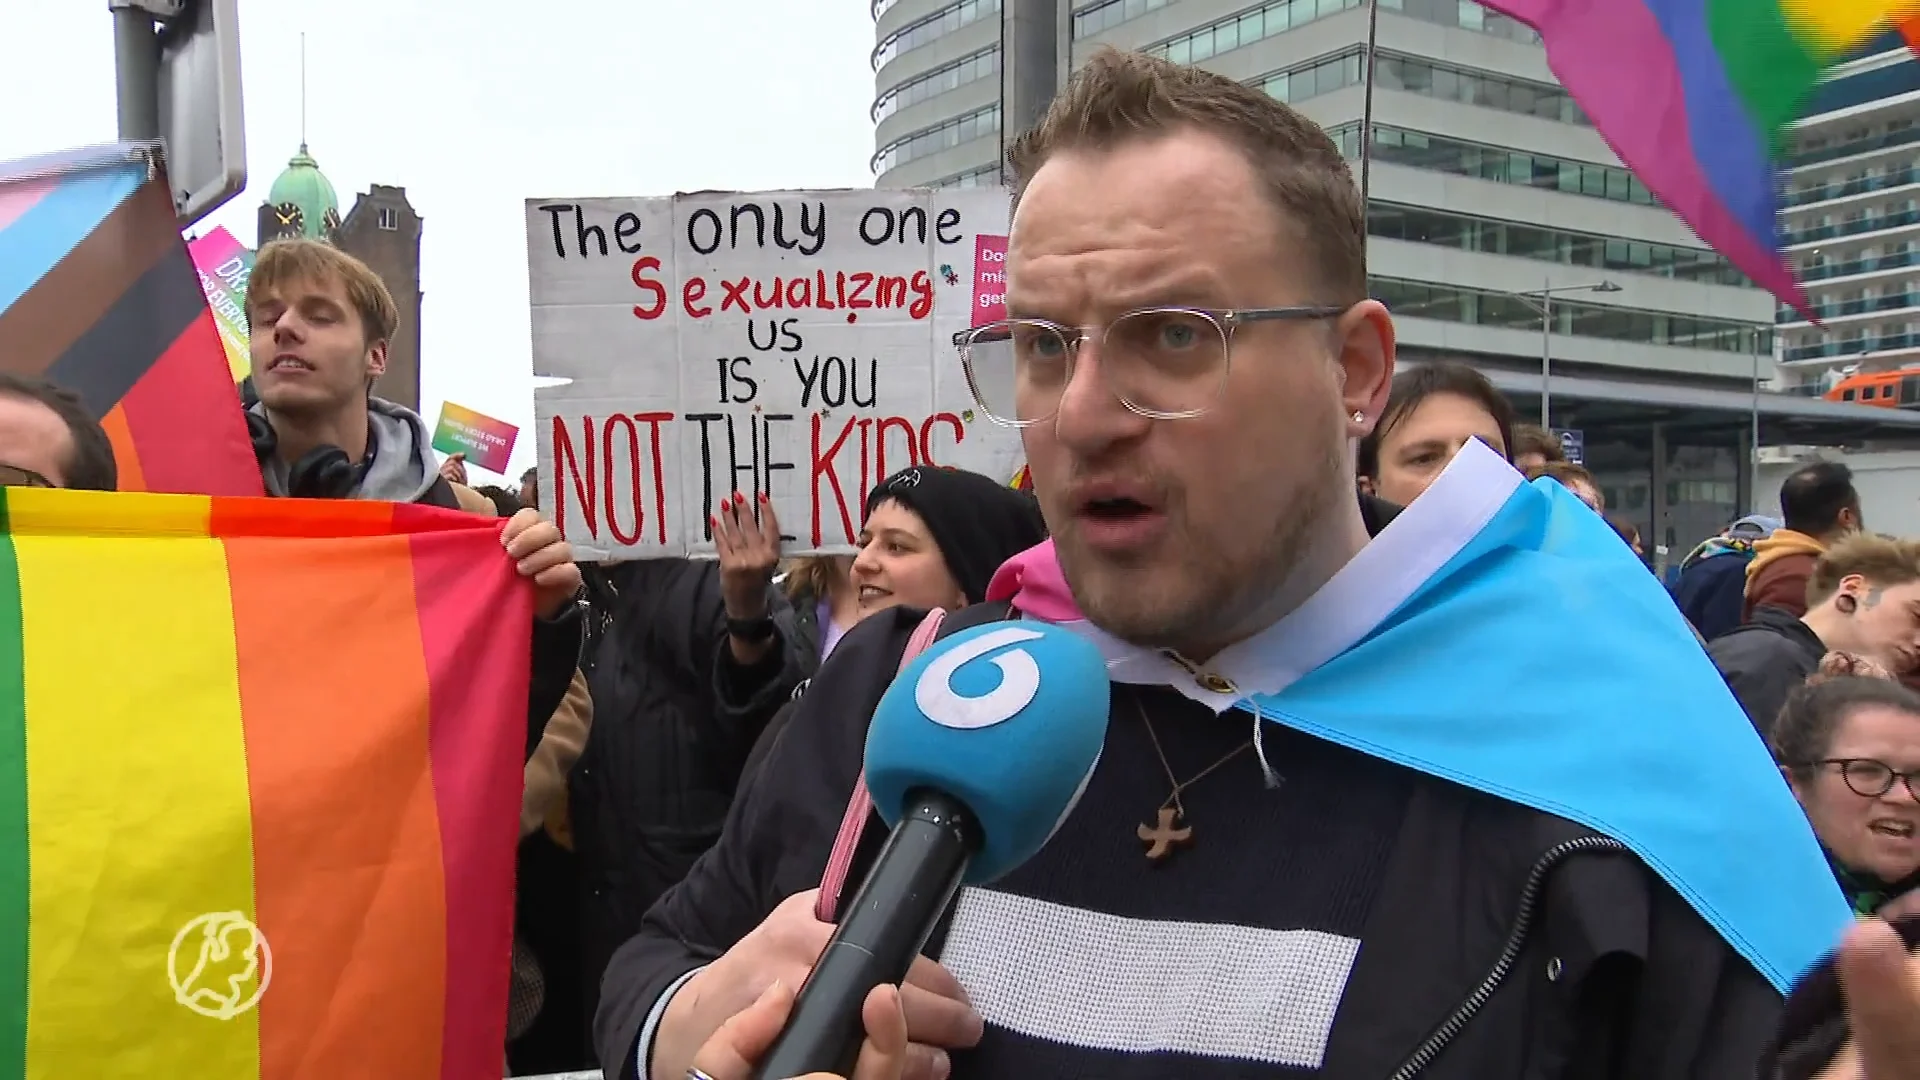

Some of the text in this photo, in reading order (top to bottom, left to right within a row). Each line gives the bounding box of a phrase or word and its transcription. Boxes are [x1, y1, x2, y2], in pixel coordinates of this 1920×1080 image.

[539, 202, 963, 259] The only one
[982, 249, 1008, 261] Do
[981, 270, 1005, 283] mi
[207, 288, 250, 338] EVERYO
[717, 356, 877, 408] IS YOU
[551, 412, 674, 546] NOT
[685, 413, 796, 543] THE
[915, 627, 1045, 730] 6
